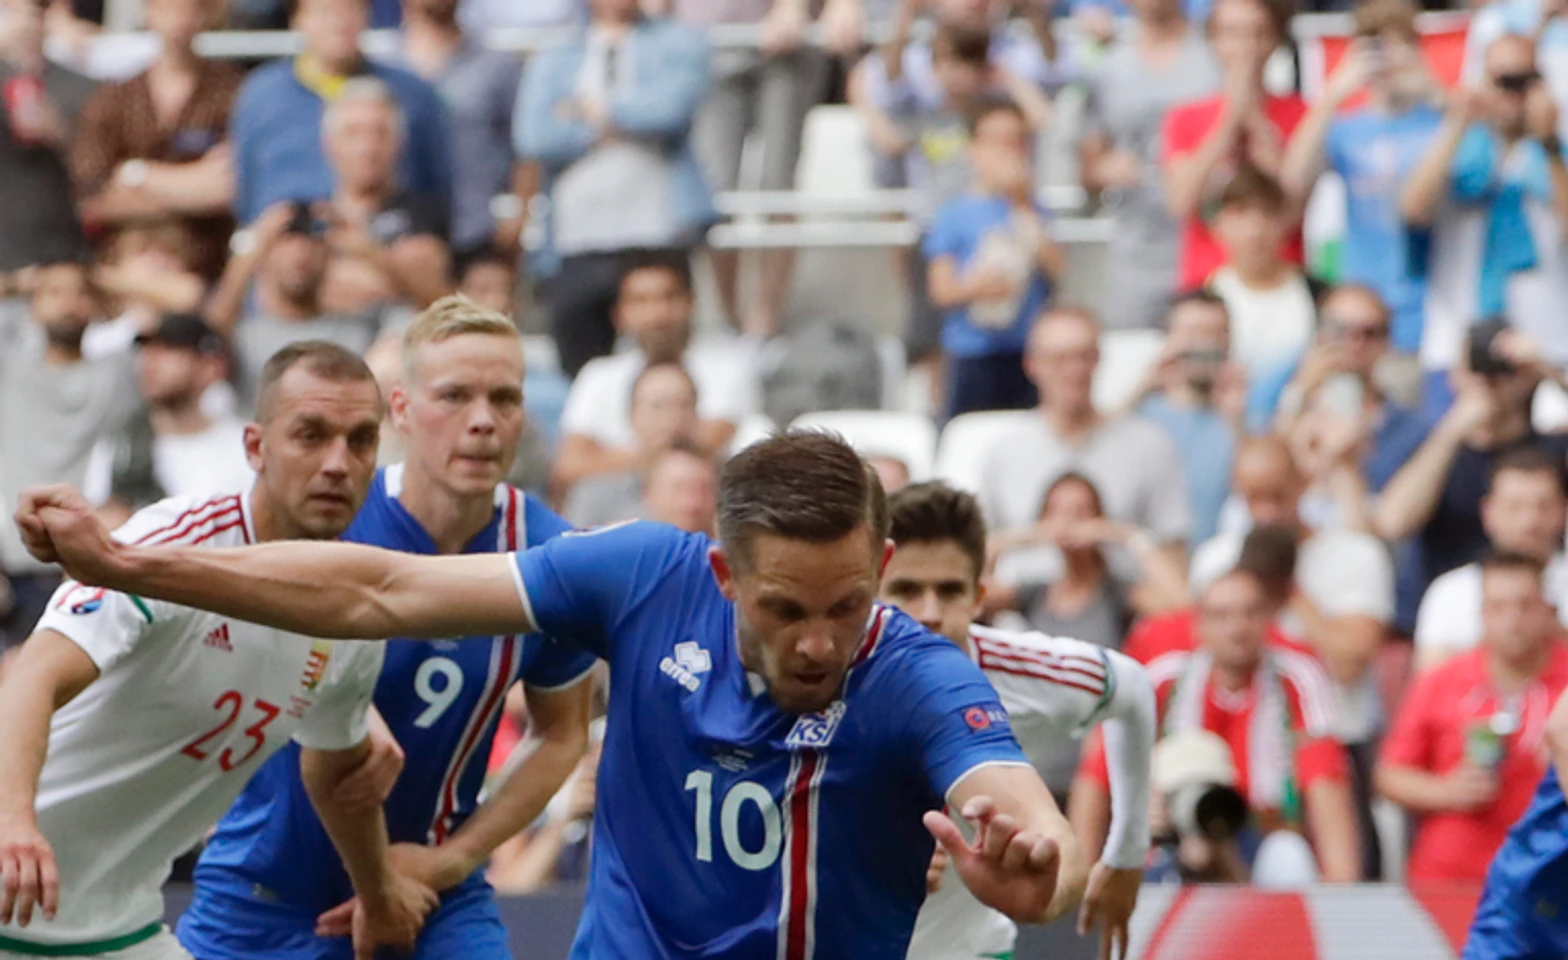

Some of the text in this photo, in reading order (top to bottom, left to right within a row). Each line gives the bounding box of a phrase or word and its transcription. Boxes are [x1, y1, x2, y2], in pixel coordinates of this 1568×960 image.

[181, 690, 280, 772] 23
[413, 656, 464, 729] 9
[684, 769, 782, 871] 10
